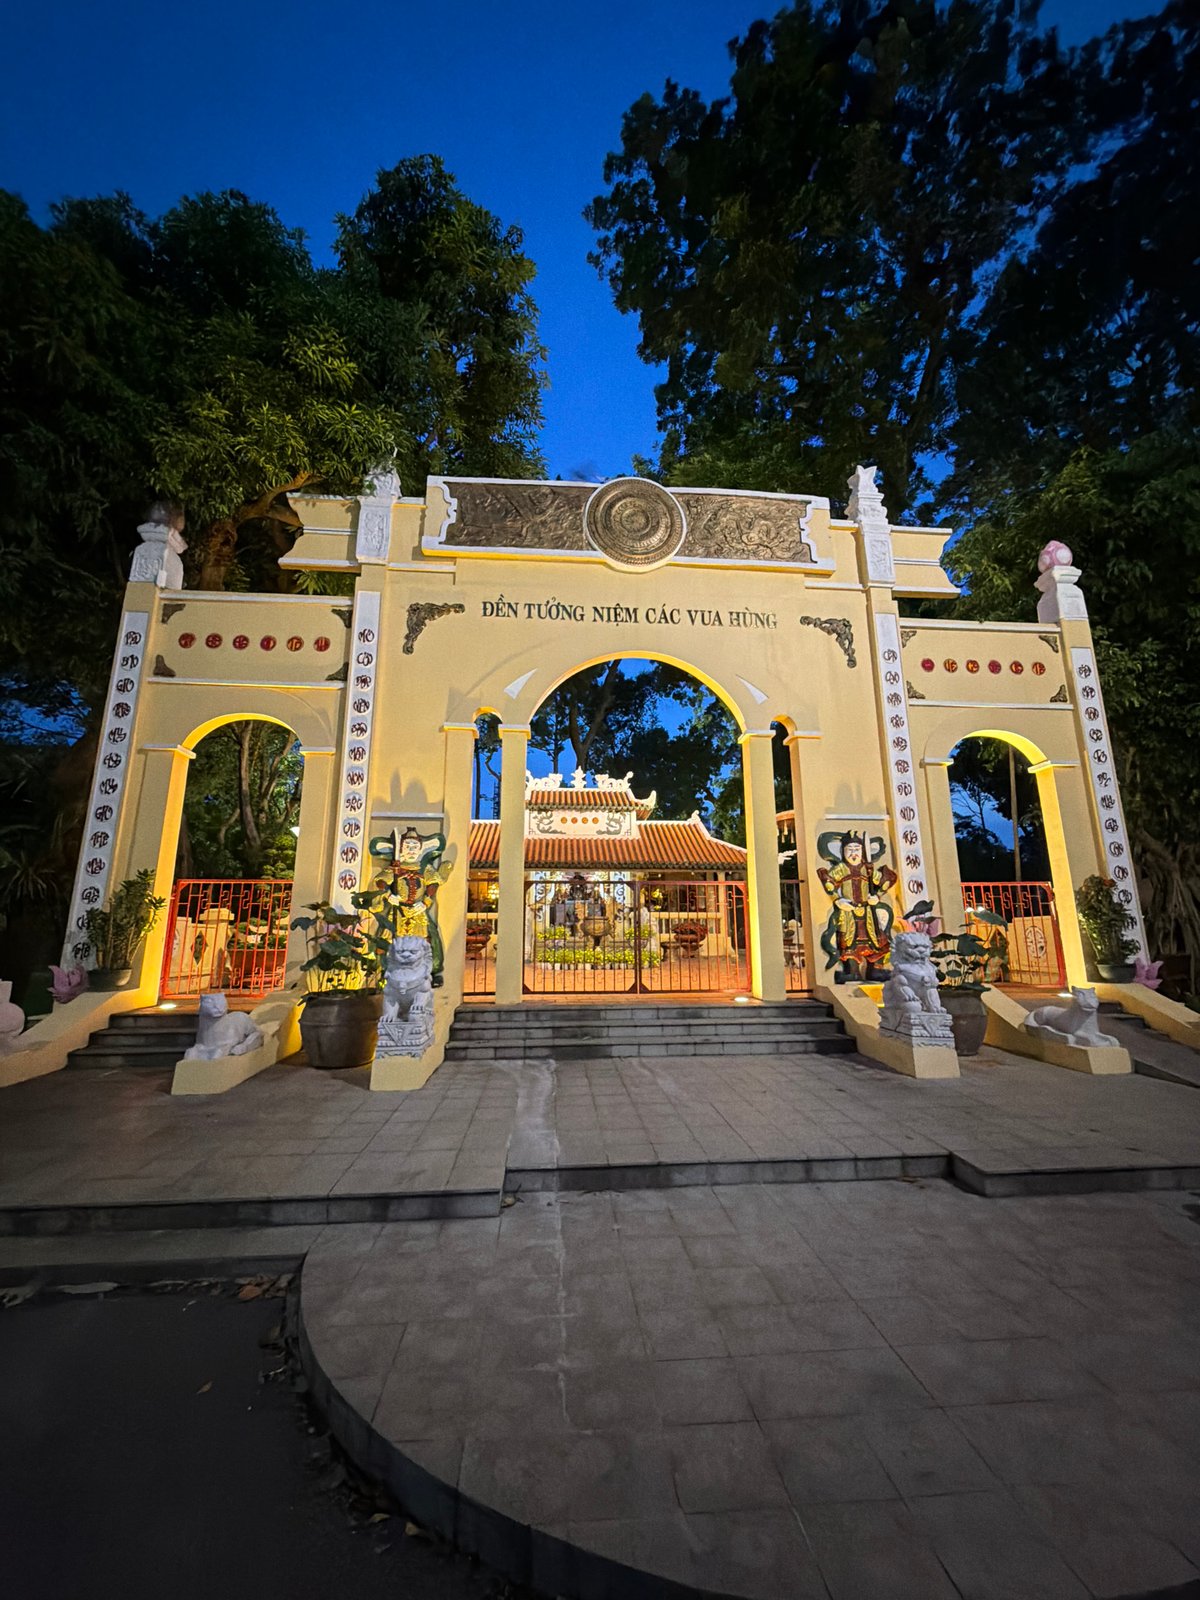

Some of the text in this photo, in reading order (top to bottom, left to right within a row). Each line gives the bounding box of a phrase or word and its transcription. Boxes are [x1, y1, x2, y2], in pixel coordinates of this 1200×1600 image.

[482, 594, 777, 630] ĐỀN TƯỞNG NIỆM CÁC VUA HÙNG
